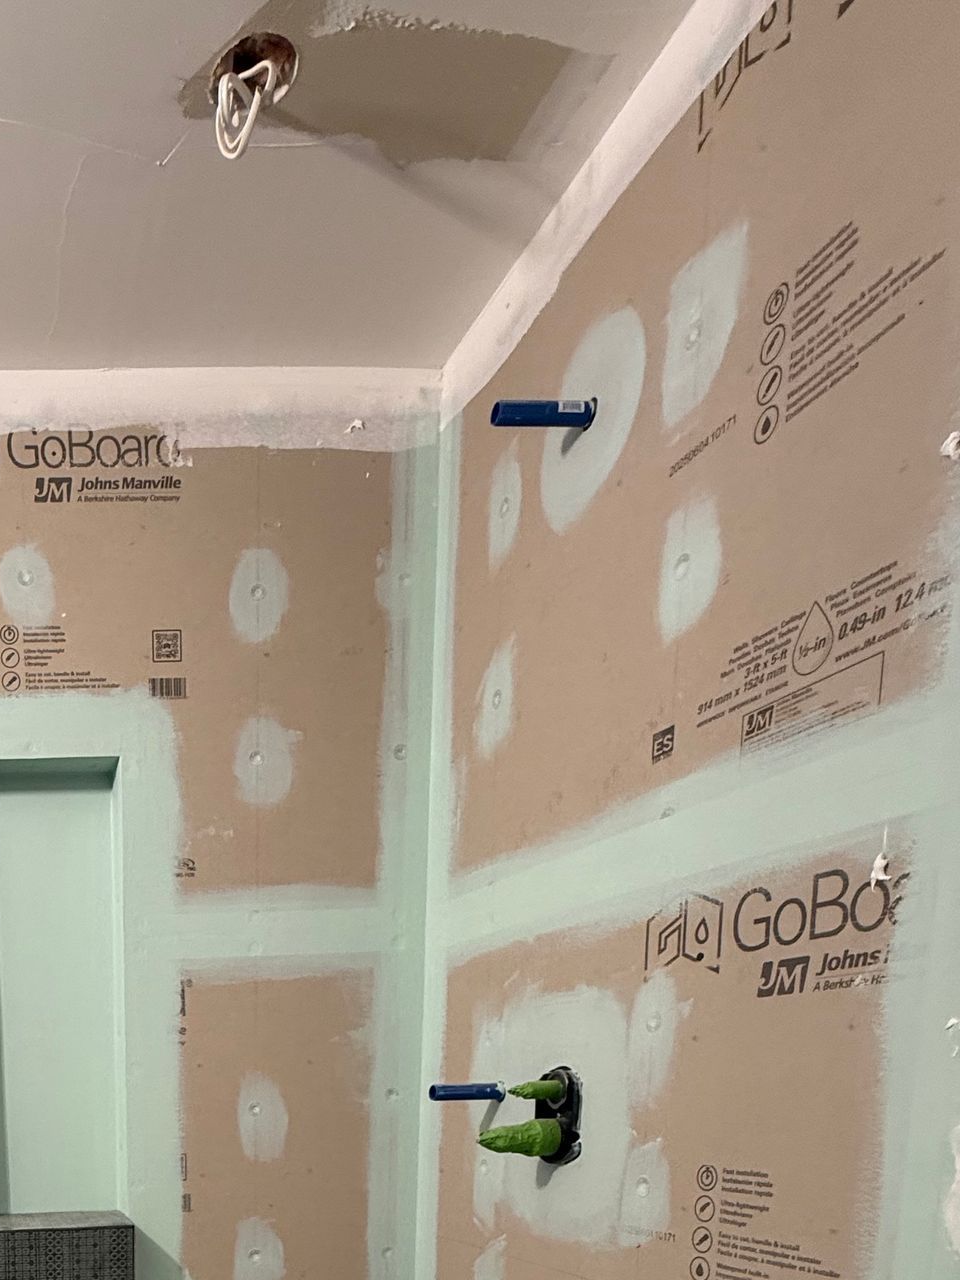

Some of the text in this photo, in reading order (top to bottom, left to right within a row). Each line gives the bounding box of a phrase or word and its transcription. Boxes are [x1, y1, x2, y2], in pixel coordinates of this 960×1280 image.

[35, 477, 72, 503] JM
[78, 476, 181, 492] Johns Manville
[116, 495, 148, 503] Hathaway
[149, 494, 181, 502] Company
[838, 605, 886, 641] 0.49-in
[895, 582, 926, 612] 12.4
[744, 662, 760, 679] 3-ft
[771, 648, 788, 665] 5-ft
[697, 698, 714, 715] 914
[743, 673, 765, 692] 1524
[744, 704, 775, 736] JM
[653, 731, 674, 760] ES
[757, 956, 810, 998] JM
[815, 949, 882, 976] Johns
